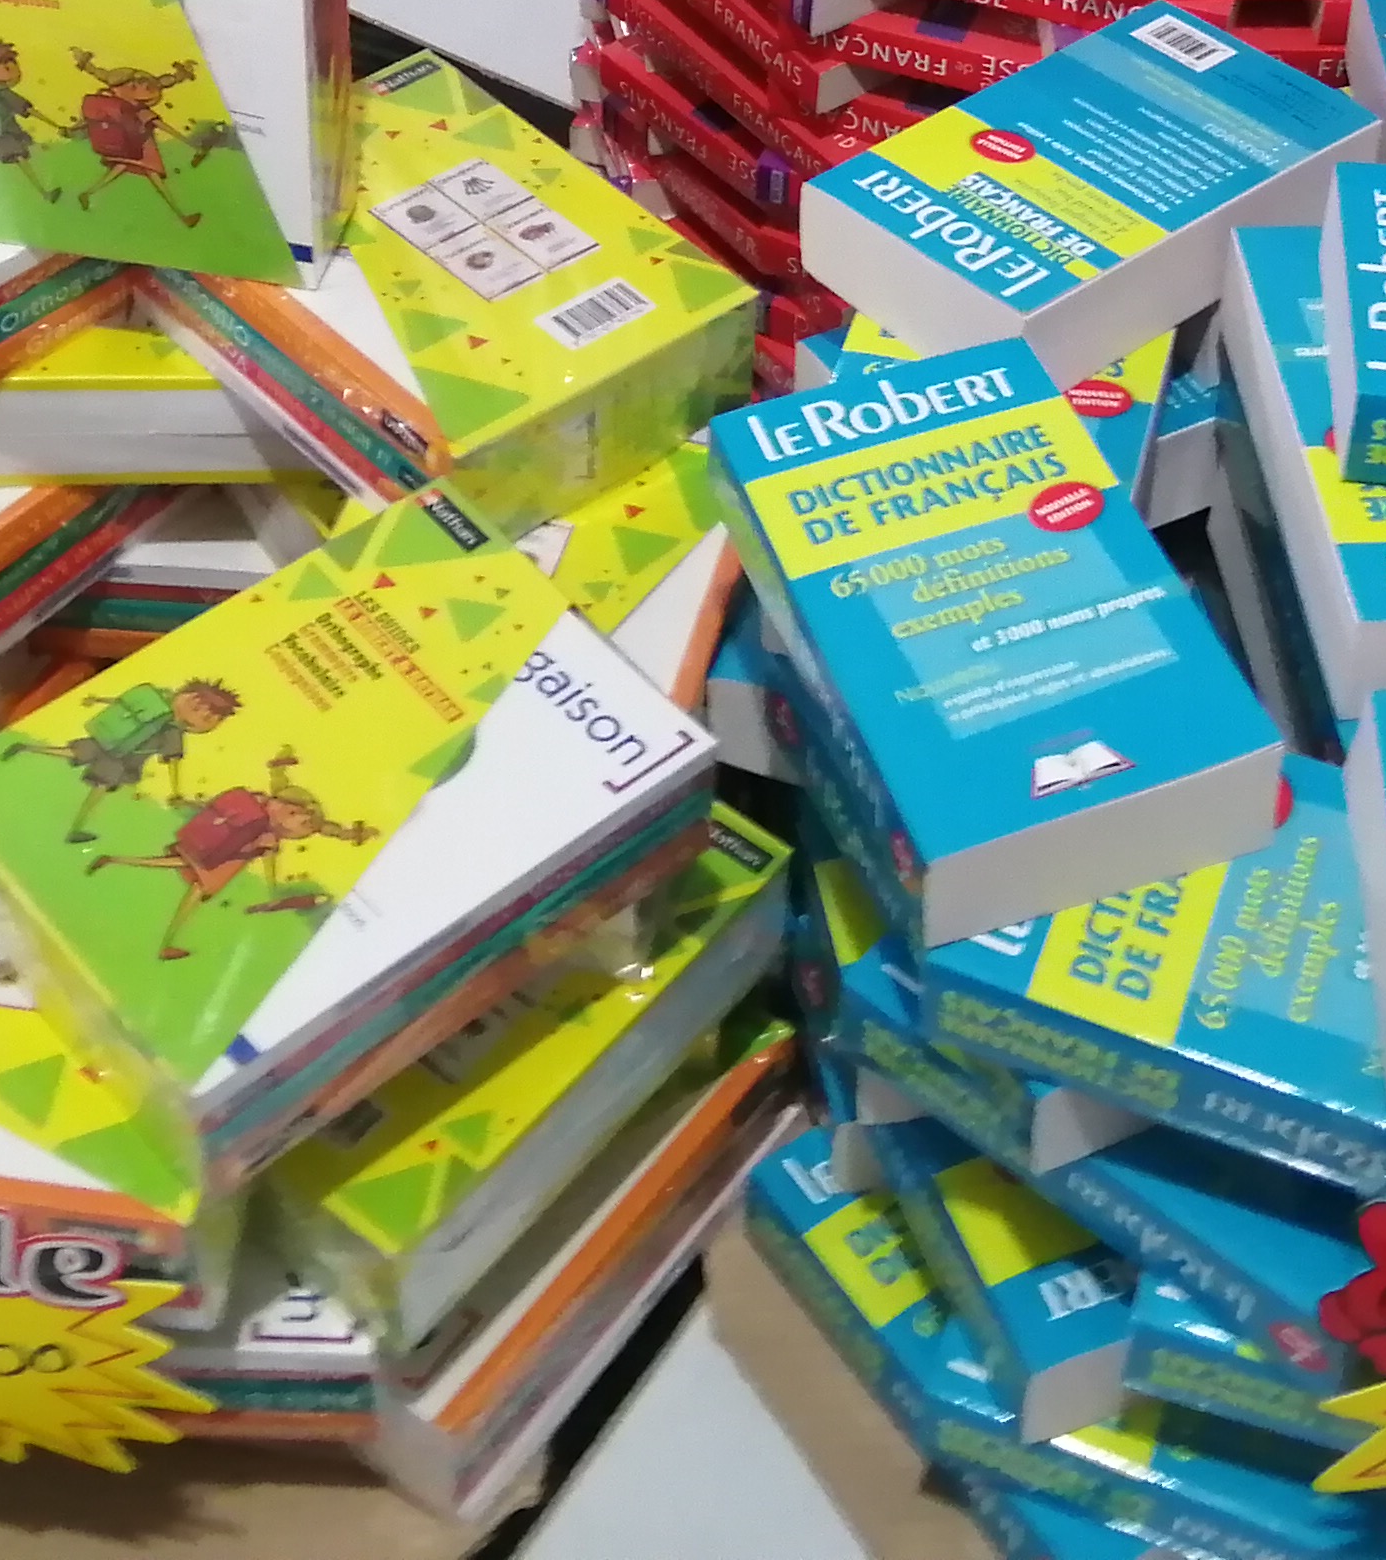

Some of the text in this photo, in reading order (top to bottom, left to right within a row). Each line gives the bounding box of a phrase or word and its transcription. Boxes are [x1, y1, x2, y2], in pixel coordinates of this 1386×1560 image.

[787, 423, 1053, 518] DICTIONNAIRE
[804, 452, 1068, 546] DE FRANÇAIS
[421, 492, 490, 551] Nathan
[912, 548, 1070, 603] définitions
[934, 537, 1007, 568] mots
[892, 587, 1024, 641] exemples
